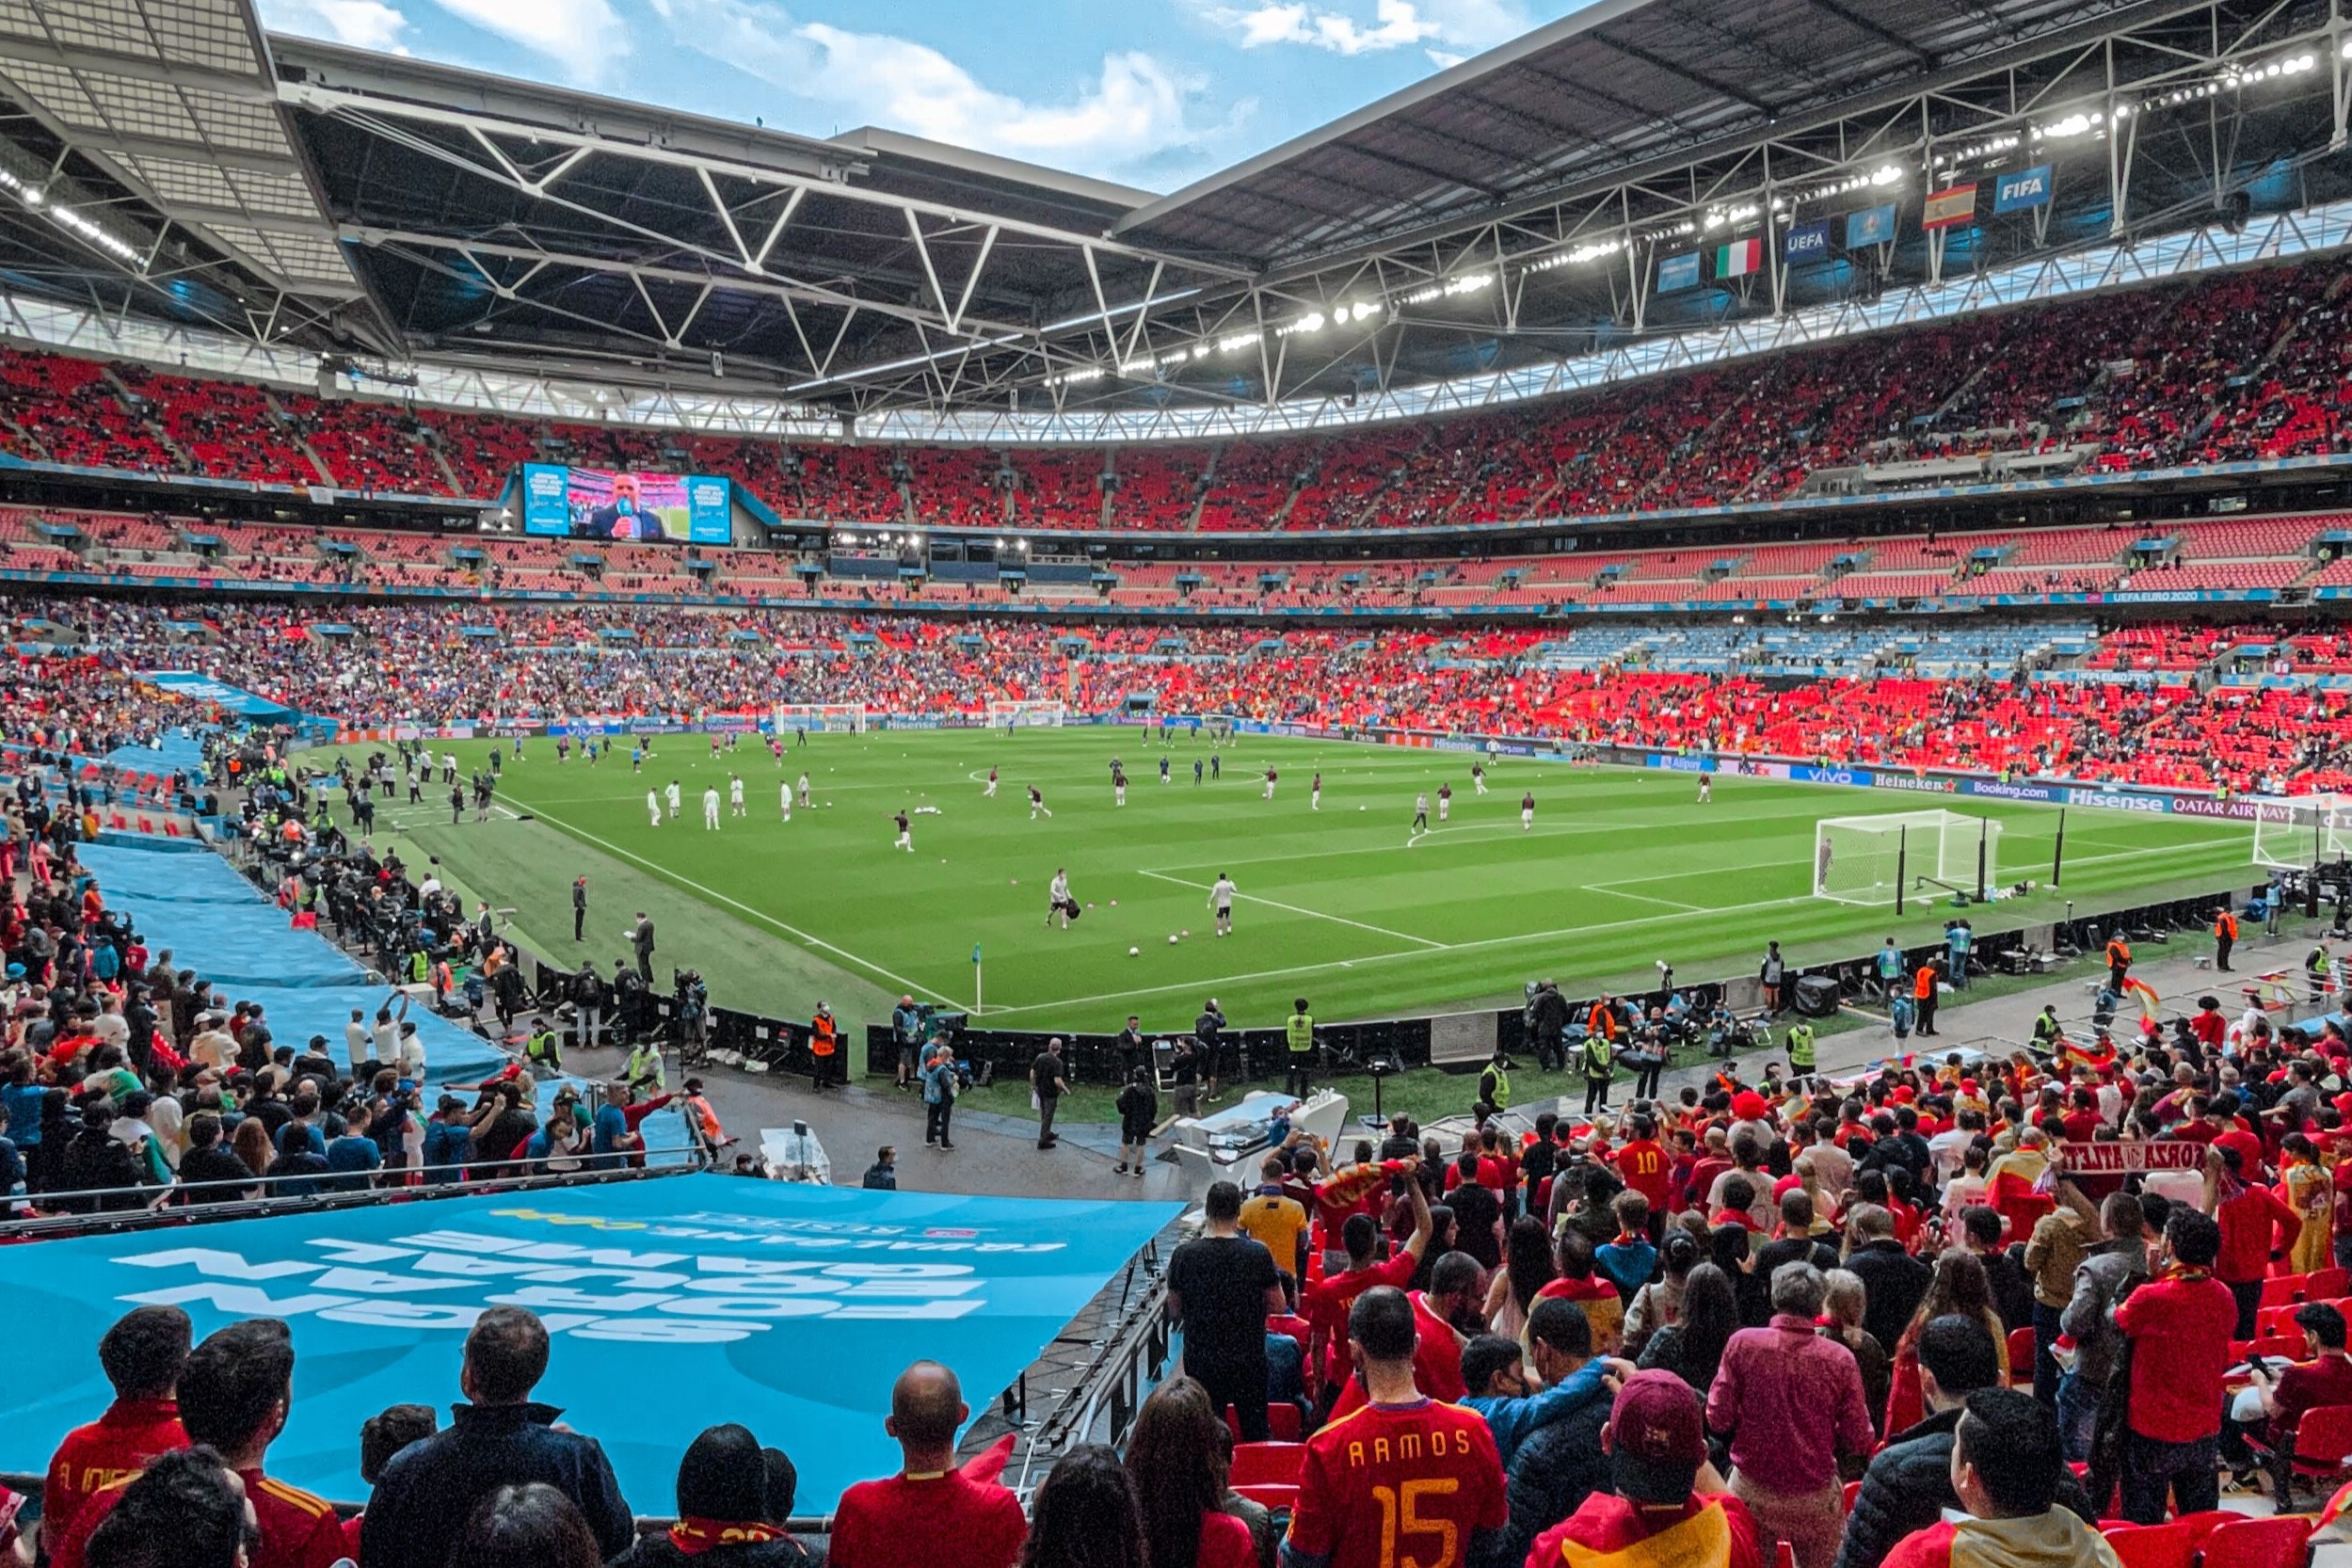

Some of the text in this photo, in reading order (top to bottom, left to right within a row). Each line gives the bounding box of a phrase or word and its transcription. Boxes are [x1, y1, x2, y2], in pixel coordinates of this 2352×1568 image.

[2002, 178, 2042, 200] FIFA
[1788, 232, 1824, 251] UEFA
[2113, 591, 2198, 601] UEFA EURO 2020
[499, 728, 532, 737] TikTok
[567, 726, 605, 735] vivo
[630, 724, 683, 733] Booking.com
[887, 720, 937, 729] Hisense
[1433, 739, 1477, 751] Hisense
[1808, 768, 1852, 784] vivo
[1875, 774, 1944, 791] Heineken
[1974, 781, 2049, 801] Booking.com
[2069, 789, 2164, 812] Hisense
[2173, 798, 2225, 816] QATAR
[1638, 1151, 1657, 1174] 10
[390, 1230, 977, 1277] GAME
[305, 1239, 986, 1297] EQUAL
[110, 1248, 986, 1319] FOR AN
[1349, 1430, 1470, 1467] RAMOS
[1372, 1478, 1459, 1568] 15
